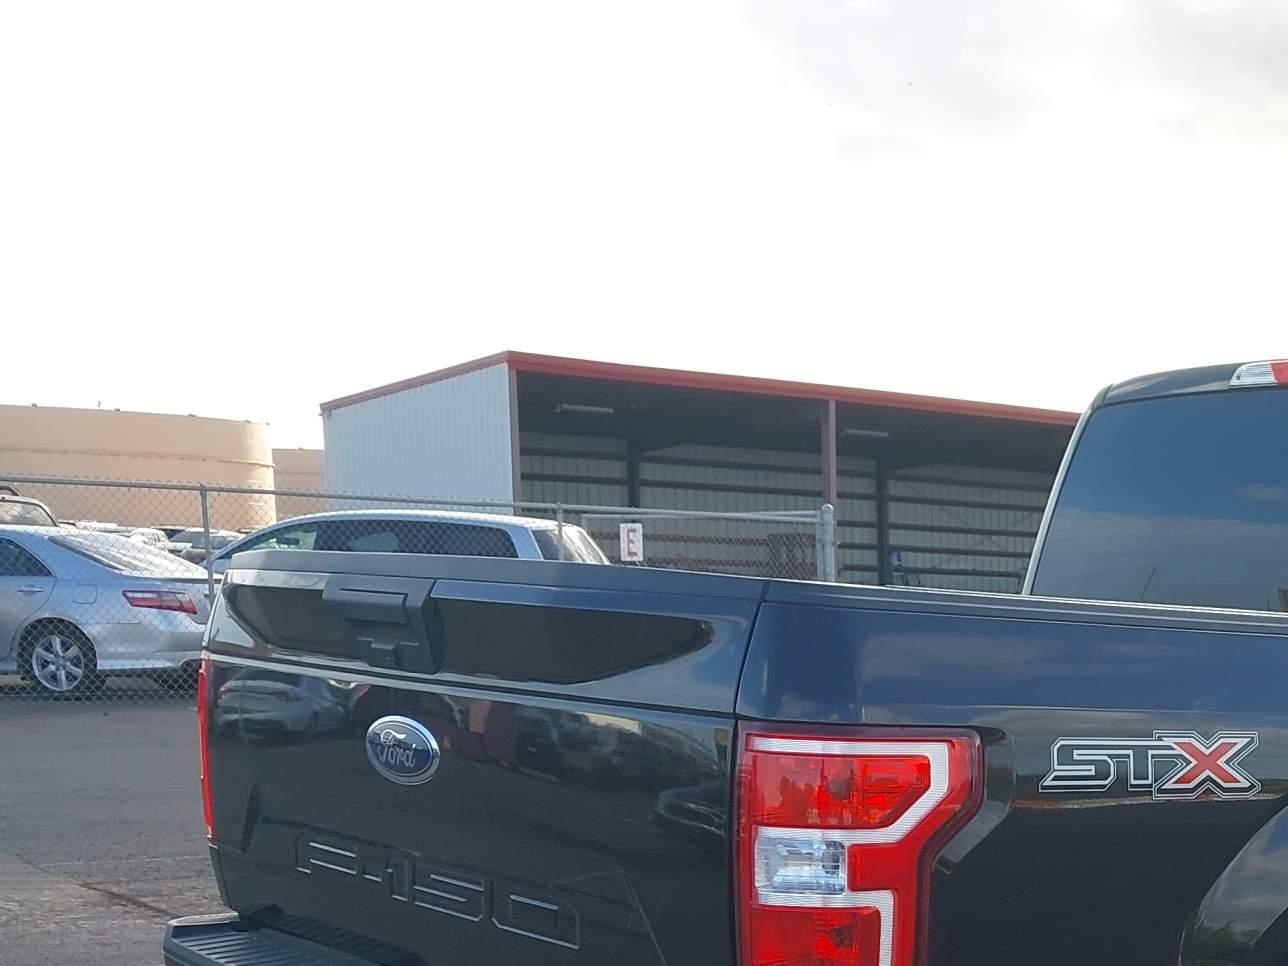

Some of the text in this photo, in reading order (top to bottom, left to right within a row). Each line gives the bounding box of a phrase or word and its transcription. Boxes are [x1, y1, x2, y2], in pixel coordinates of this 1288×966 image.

[626, 528, 638, 557] E
[377, 728, 417, 768] Ford
[1039, 730, 1262, 800] STX
[295, 832, 579, 949] F-150
